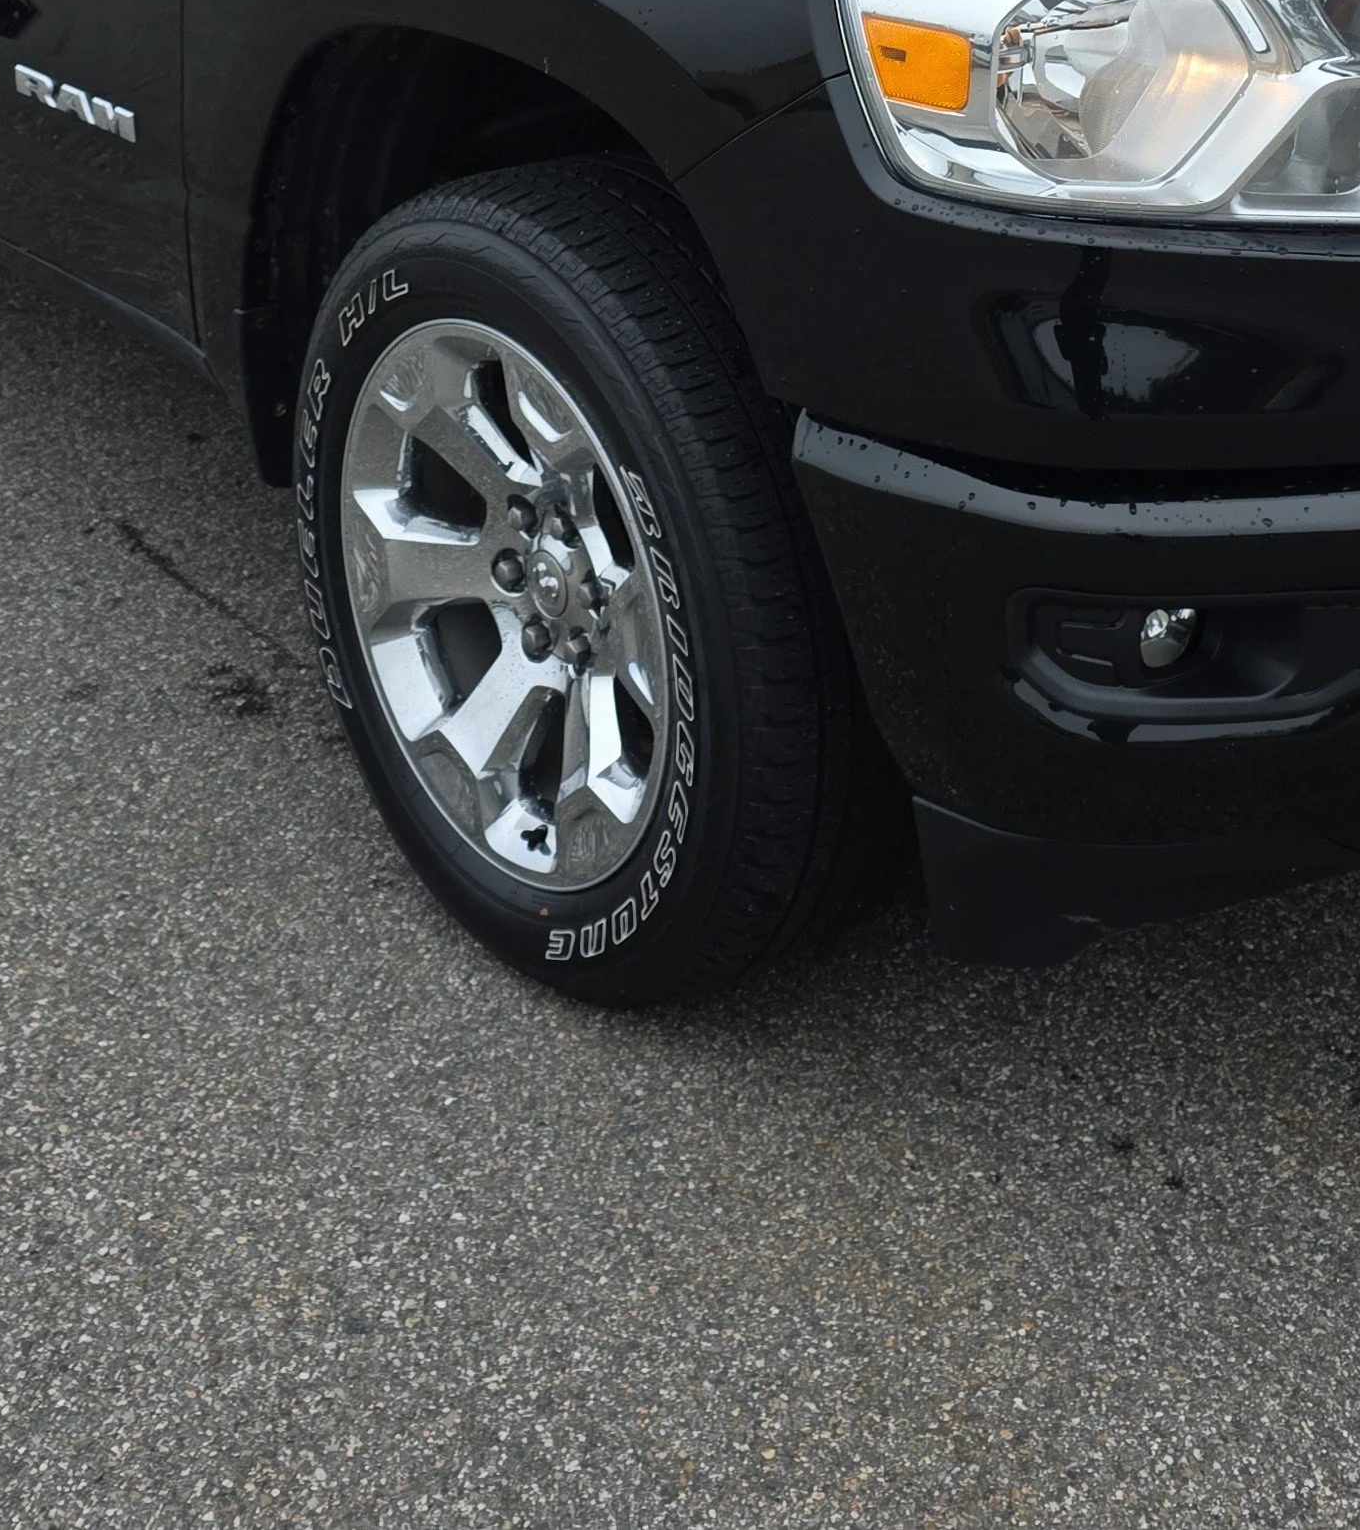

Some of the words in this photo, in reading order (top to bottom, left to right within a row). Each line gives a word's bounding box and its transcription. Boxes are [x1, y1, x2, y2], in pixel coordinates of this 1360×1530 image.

[14, 63, 137, 144] RAM
[297, 358, 353, 710] DUELER
[338, 269, 409, 347] H/L
[544, 465, 695, 961] BRIDGESTONE
